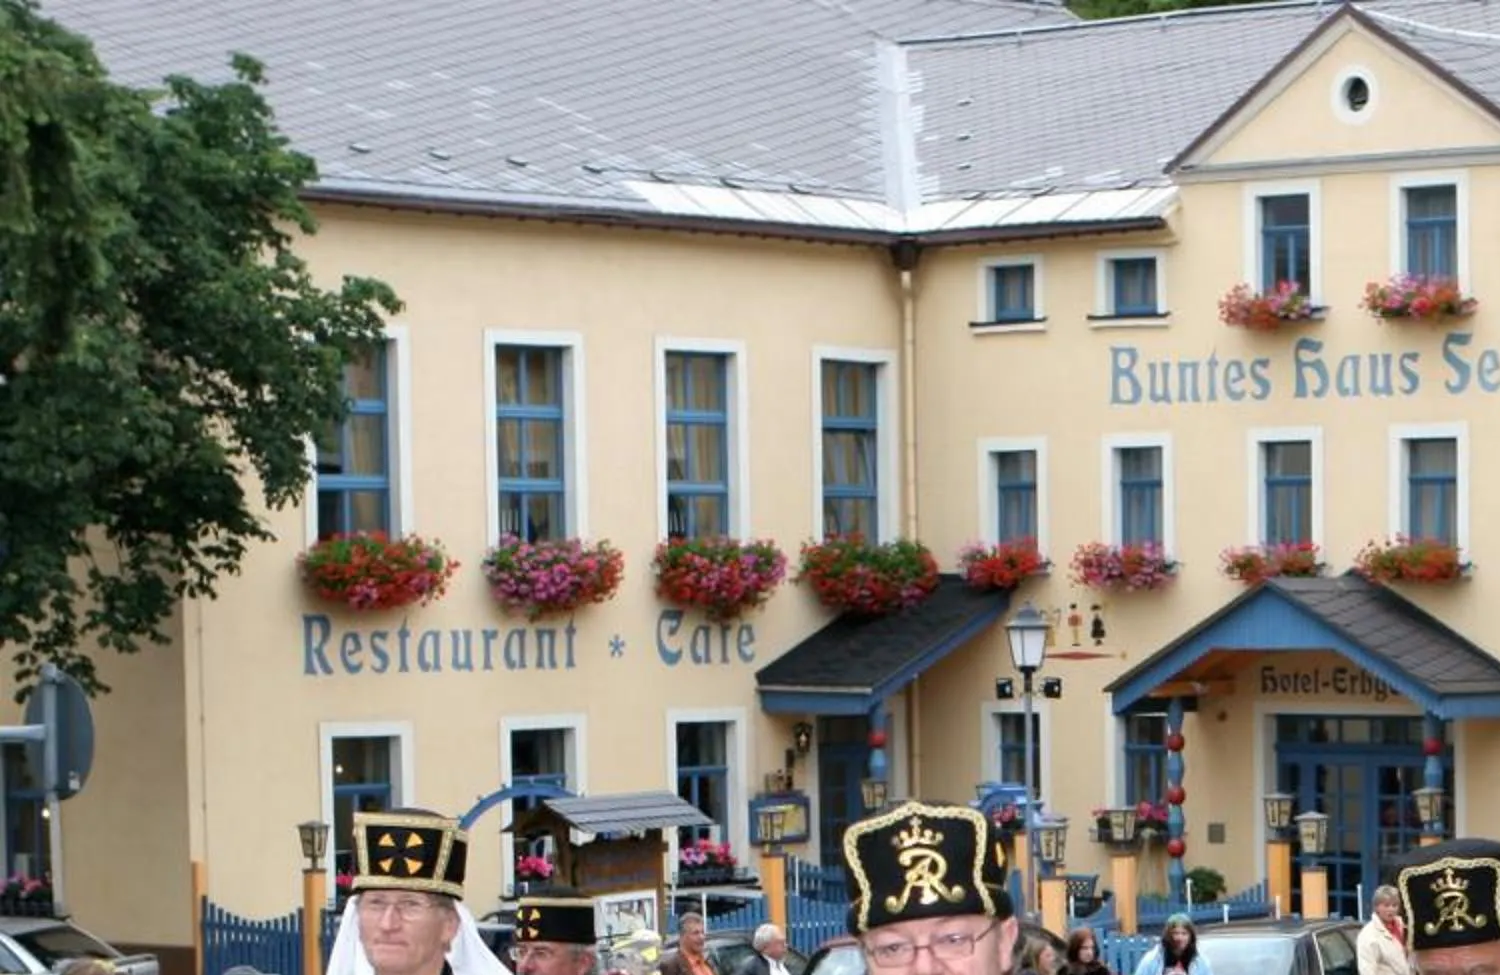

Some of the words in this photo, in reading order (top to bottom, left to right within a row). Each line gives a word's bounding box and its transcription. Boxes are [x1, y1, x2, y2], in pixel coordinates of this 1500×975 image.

[1109, 345, 1271, 405] Buntes
[1293, 338, 1419, 397] Haus
[302, 611, 577, 676] Restaurant
